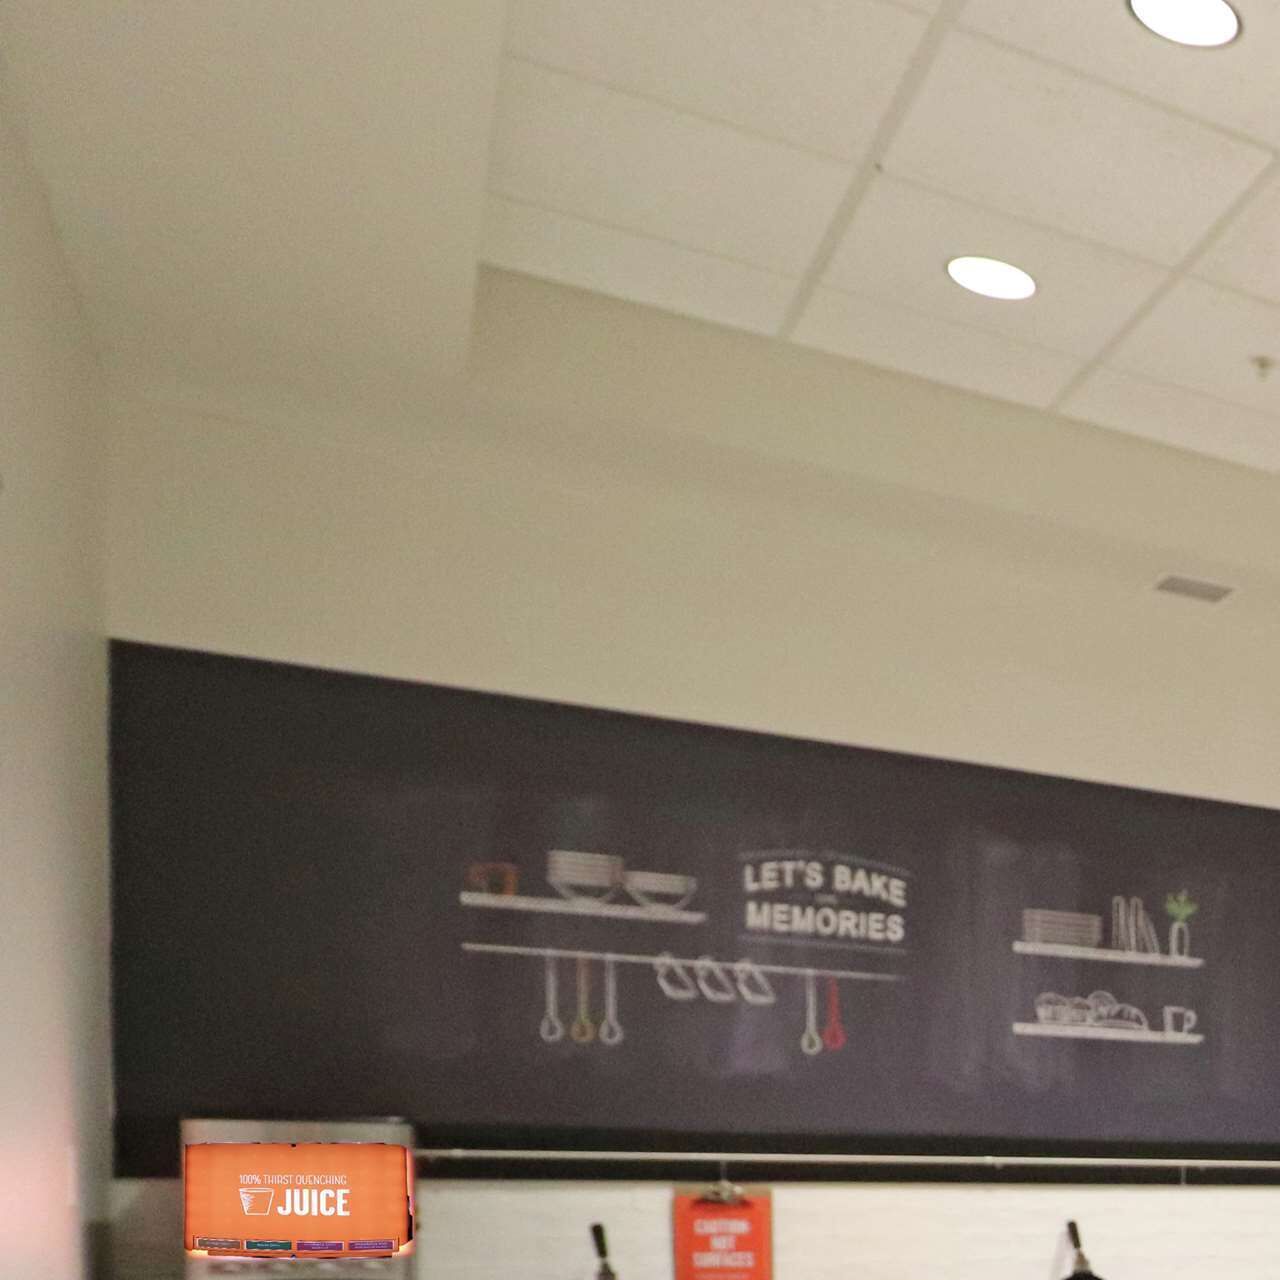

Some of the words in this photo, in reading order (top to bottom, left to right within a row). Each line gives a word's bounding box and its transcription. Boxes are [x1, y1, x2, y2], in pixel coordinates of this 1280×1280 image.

[743, 860, 824, 892] LET'S
[833, 864, 907, 908] BAKE
[744, 900, 905, 942] MEMORIES
[239, 1174, 261, 1185] 100%
[263, 1174, 293, 1185] THIRST
[295, 1174, 347, 1185] QUENCHING
[276, 1188, 351, 1216] JUICE
